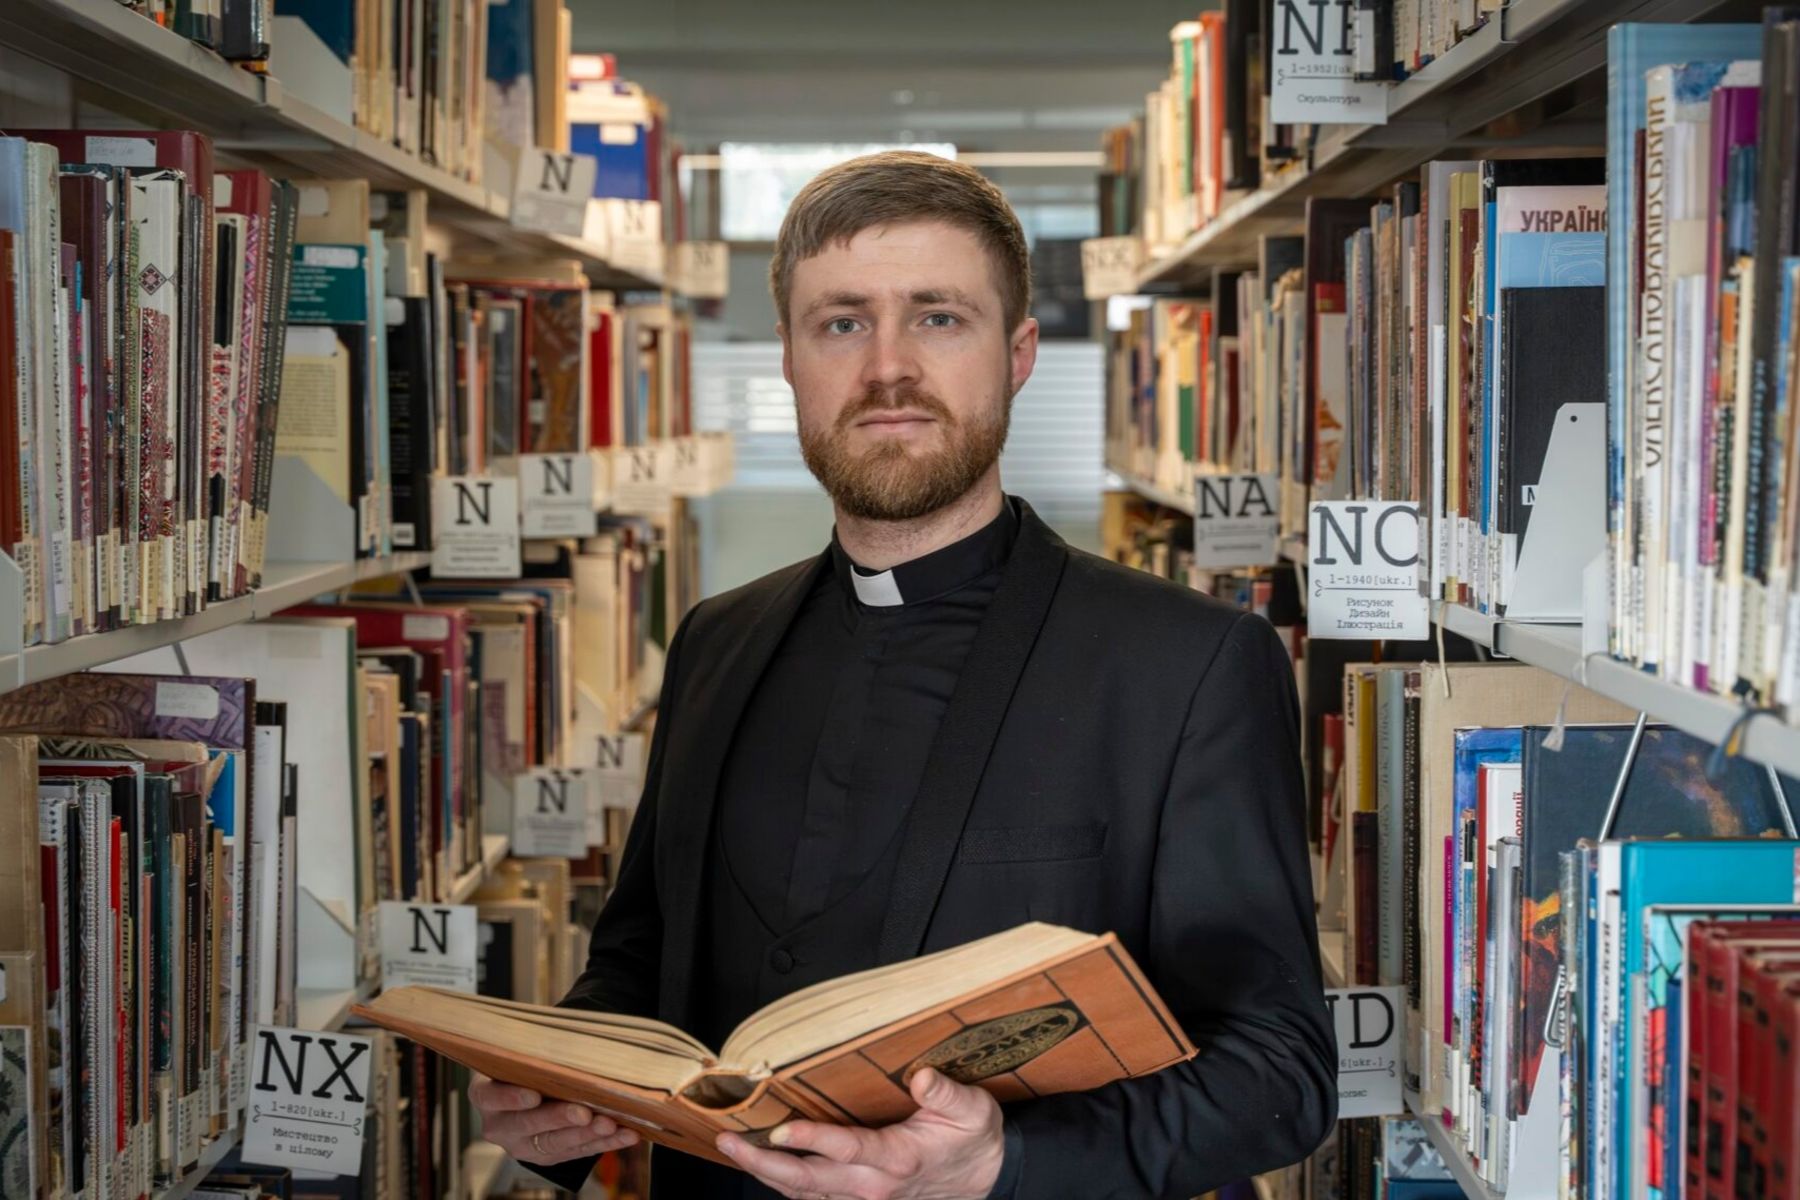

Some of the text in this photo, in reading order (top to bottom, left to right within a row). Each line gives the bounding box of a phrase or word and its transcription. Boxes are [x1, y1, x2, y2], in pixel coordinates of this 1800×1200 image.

[1297, 94, 1361, 106] Скульптура
[539, 154, 575, 193] N
[540, 457, 573, 495] N
[453, 482, 493, 525] N
[1195, 476, 1275, 518] NA
[1346, 597, 1394, 609] Рисунок
[1349, 608, 1390, 619] Дизайн
[1337, 619, 1404, 632] Ілюстрація
[596, 733, 625, 770] N
[535, 776, 569, 814] N
[408, 907, 451, 955] N
[255, 1030, 369, 1103] NX
[273, 1127, 339, 1145] Мистецтво
[289, 1144, 334, 1159] цілому
